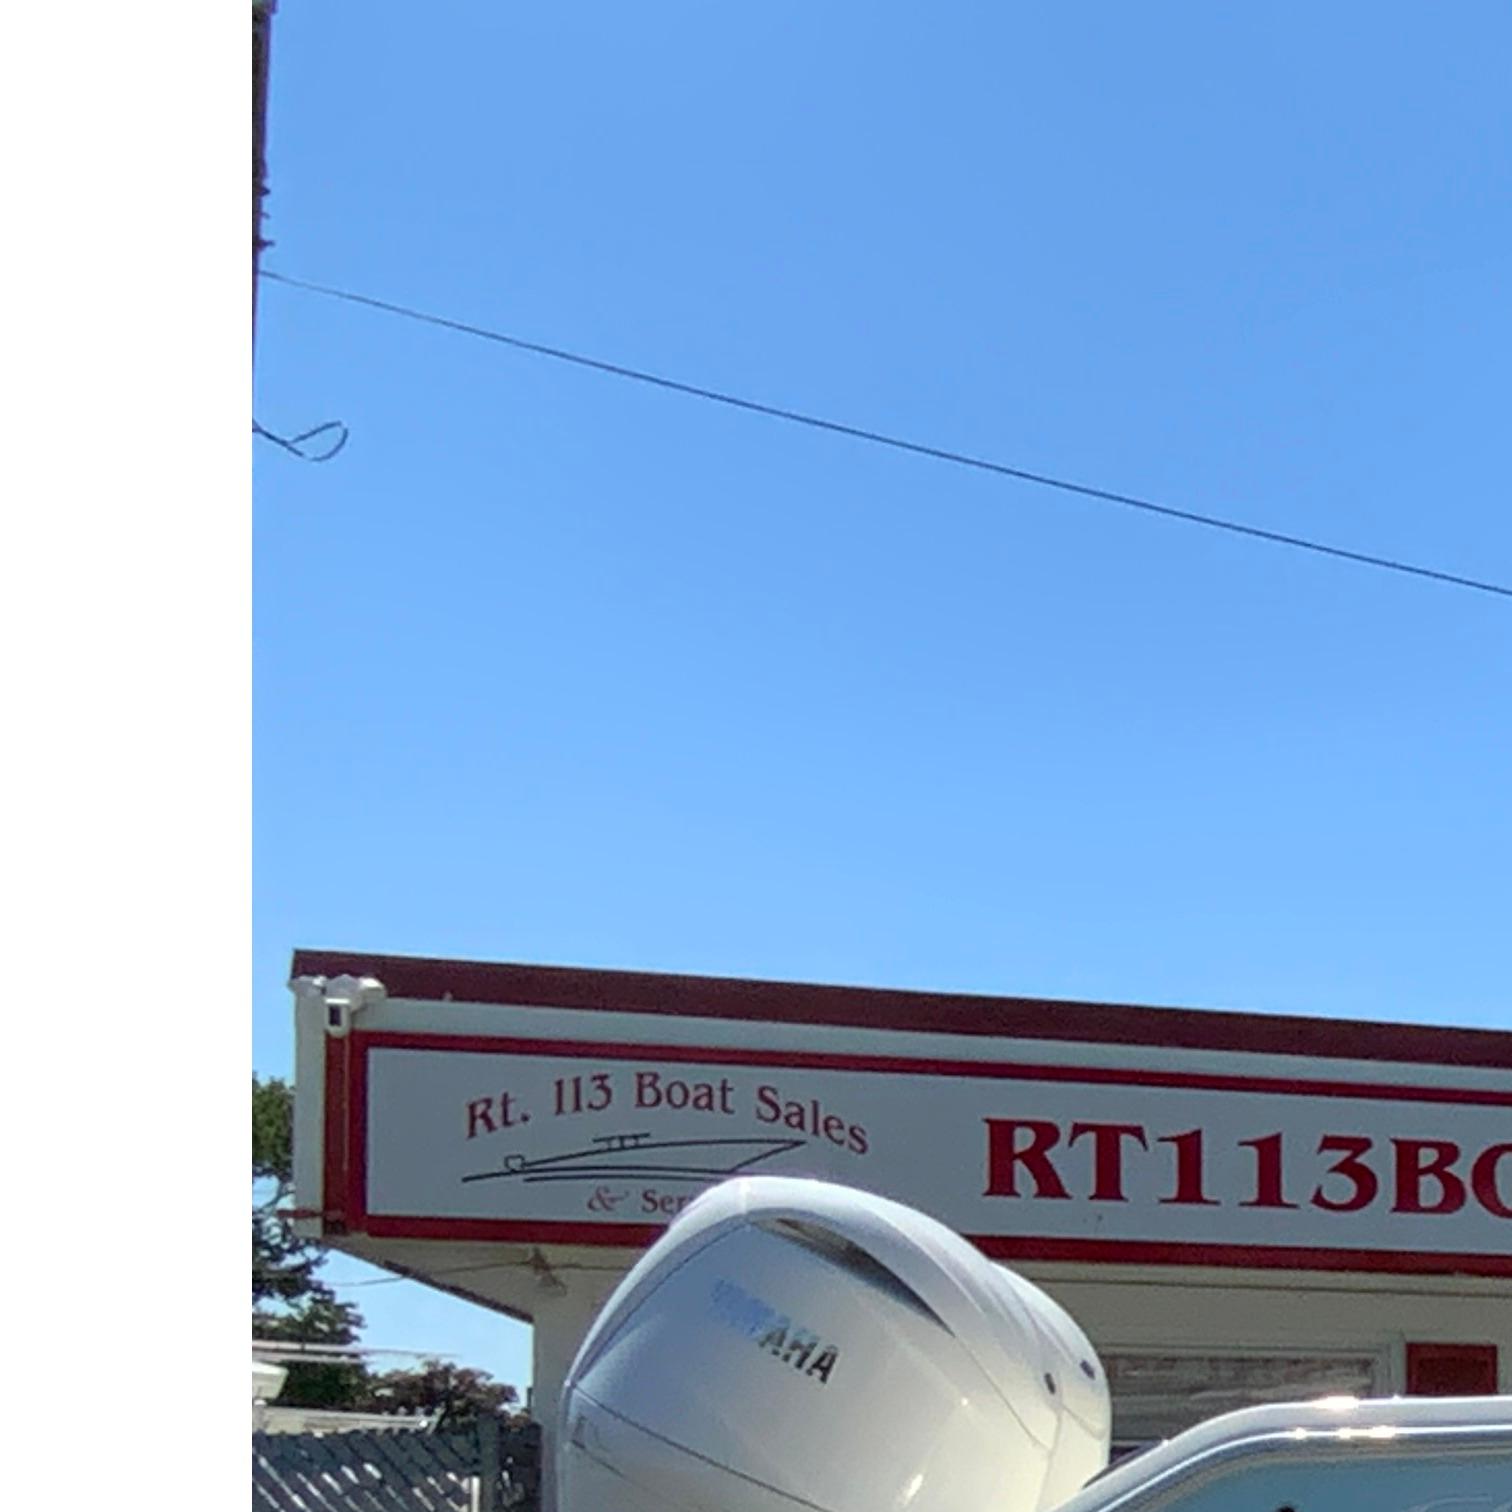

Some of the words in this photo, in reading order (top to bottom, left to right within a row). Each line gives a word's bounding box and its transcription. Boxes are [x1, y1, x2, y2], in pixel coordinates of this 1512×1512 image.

[465, 1092, 531, 1138] Rt.
[554, 1073, 613, 1116] 113
[635, 1071, 735, 1115] Boat
[755, 1085, 870, 1155] Sales
[587, 1185, 629, 1213] &
